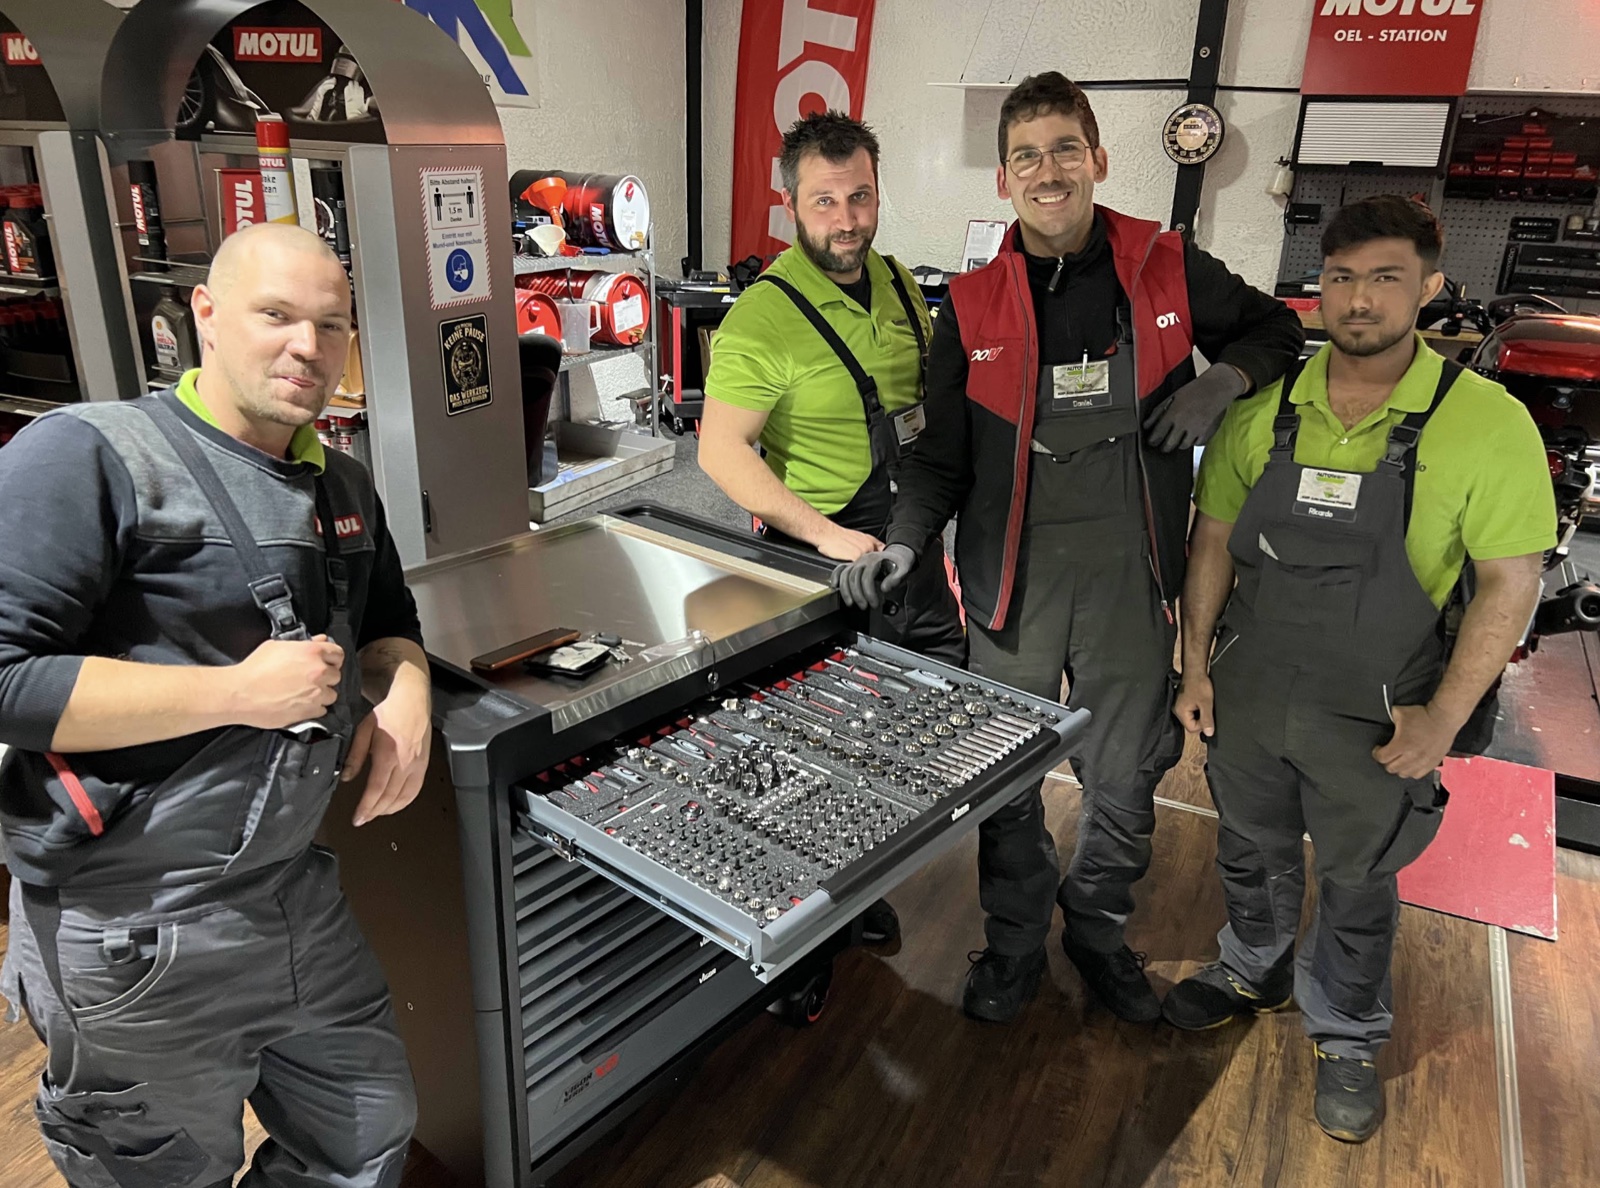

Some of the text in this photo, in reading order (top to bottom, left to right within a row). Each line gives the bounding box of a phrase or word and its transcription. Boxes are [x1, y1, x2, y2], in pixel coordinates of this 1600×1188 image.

[1333, 29, 1363, 42] OEL
[1378, 29, 1448, 42] STATION
[238, 32, 319, 58] MOTUL
[259, 158, 285, 167] OTUL
[429, 178, 441, 187] Bitte
[441, 177, 460, 186] Abstand
[131, 186, 146, 231] MOTUL
[441, 231, 457, 240] Eintritt
[5, 226, 20, 270] MOTUL
[455, 238, 483, 247] Nasenschutz
[444, 327, 486, 351] KEINE PAUSE
[449, 385, 489, 404] DAS WERKZEUG
[1072, 398, 1093, 408] Daniel
[1308, 507, 1334, 518] Ricardo
